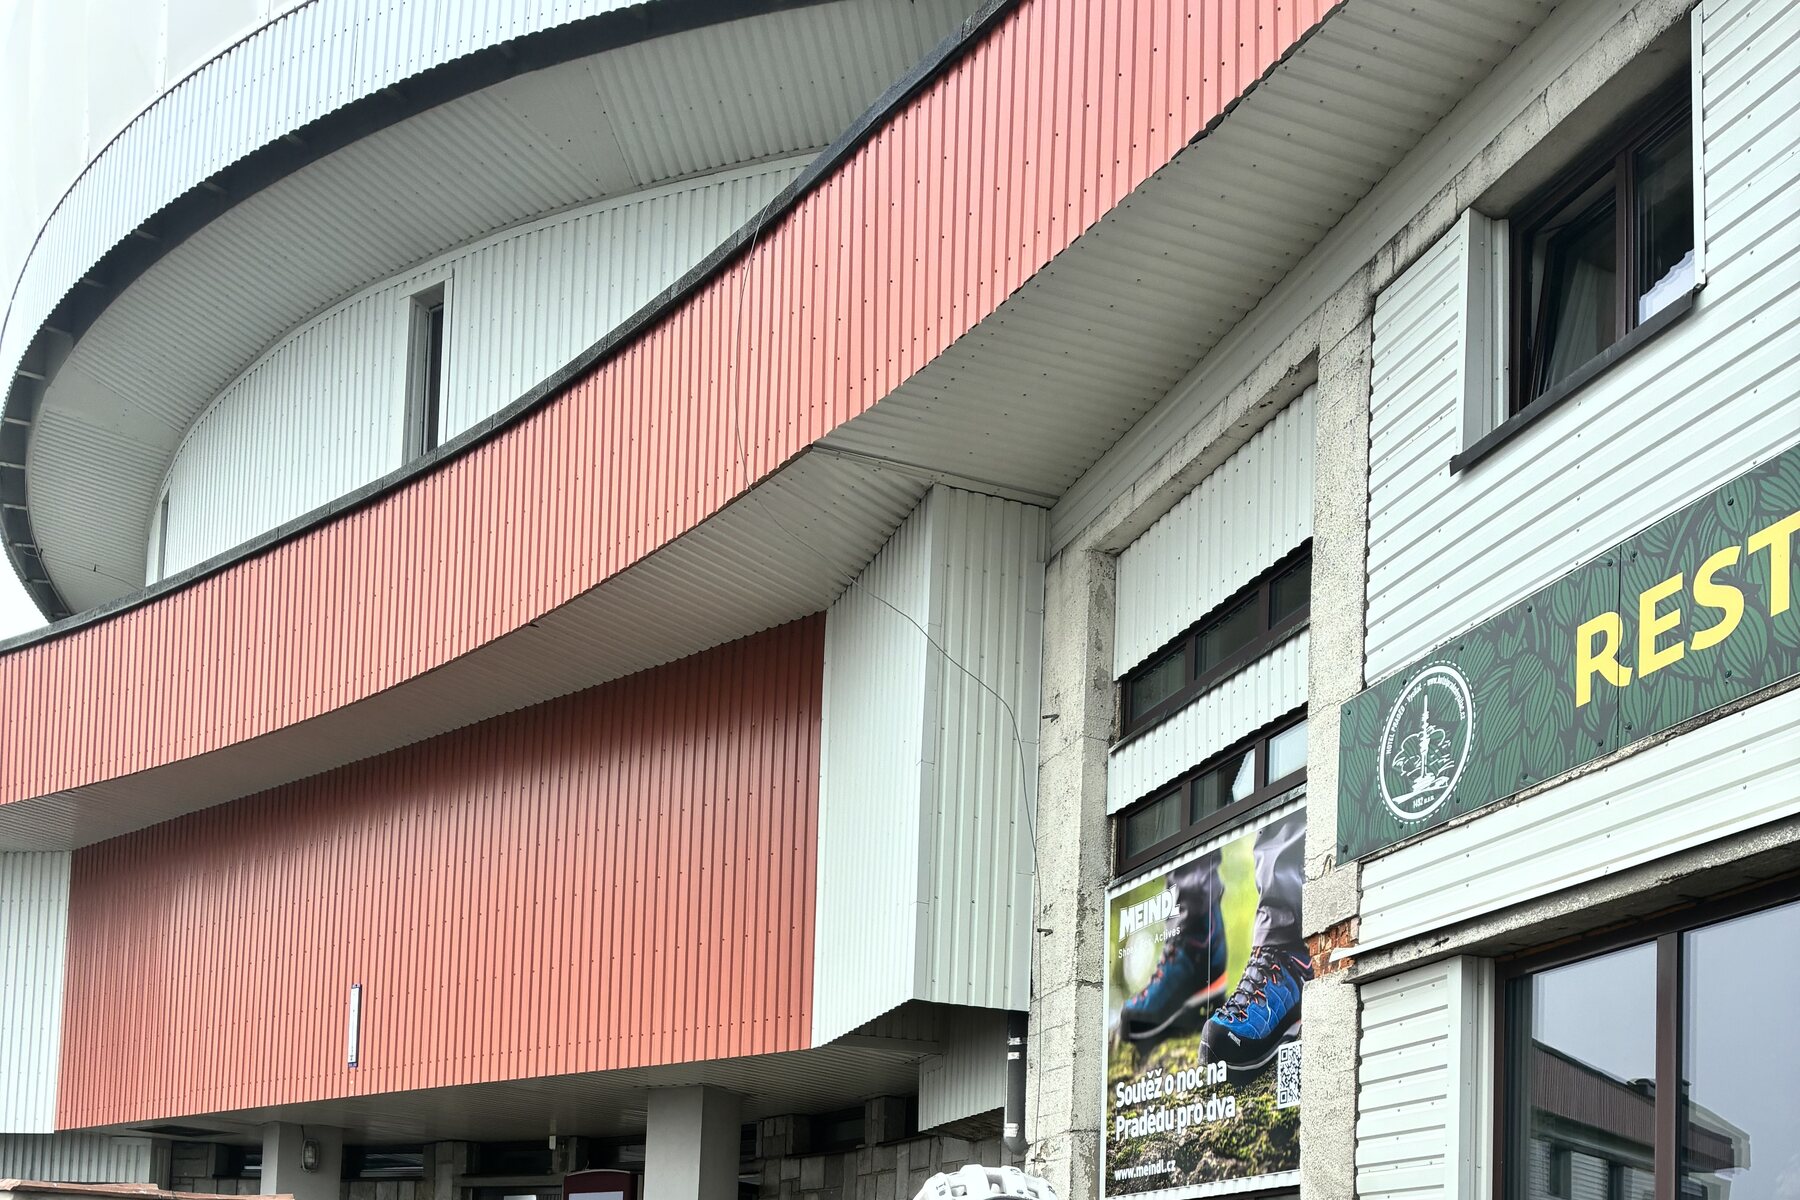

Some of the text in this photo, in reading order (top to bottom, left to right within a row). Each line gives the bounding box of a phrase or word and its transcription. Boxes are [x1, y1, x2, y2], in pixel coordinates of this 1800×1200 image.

[1576, 511, 1800, 708] REST
[1118, 884, 1181, 942] MEINDL
[1154, 926, 1181, 944] Actives
[1116, 1060, 1228, 1108] Soutěž o noc na
[1115, 1093, 1236, 1141] Pradědu pro dva
[1114, 1159, 1176, 1181] www.meindl.cz
